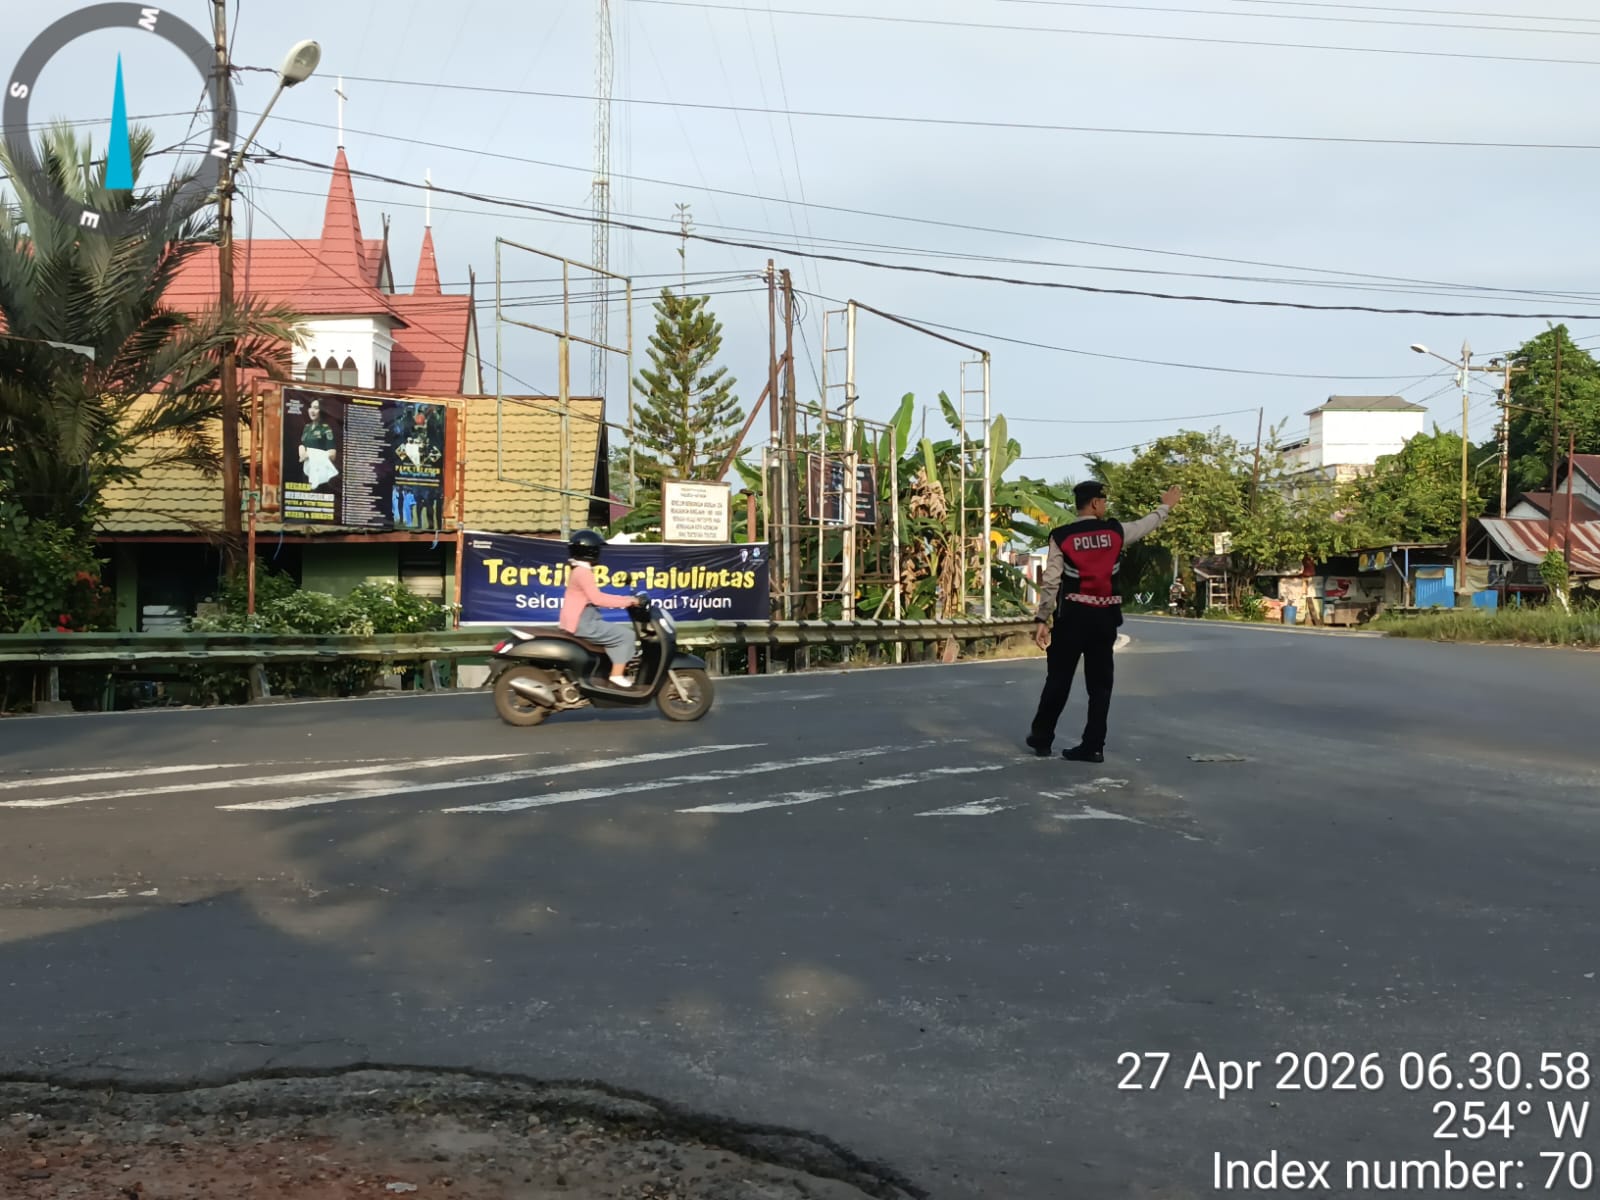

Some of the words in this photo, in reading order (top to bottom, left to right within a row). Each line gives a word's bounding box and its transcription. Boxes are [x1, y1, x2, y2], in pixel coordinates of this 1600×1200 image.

[1073, 533, 1112, 551] POLISI
[593, 565, 755, 590] Berlalulintas
[680, 595, 732, 614] Tujuan
